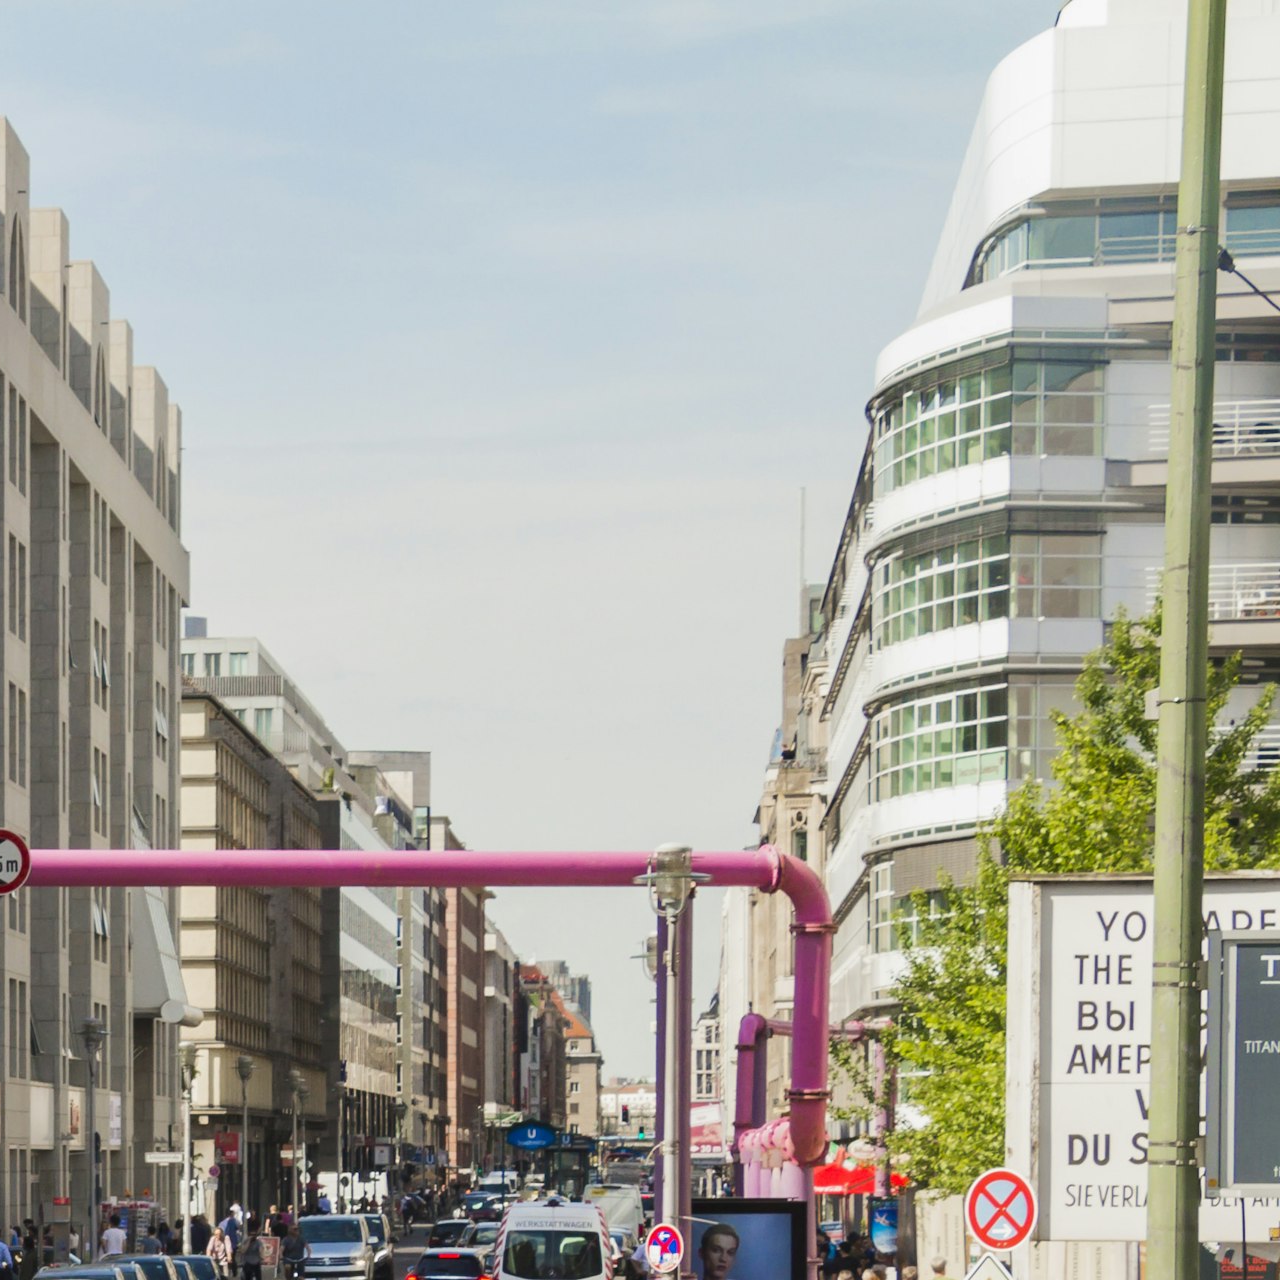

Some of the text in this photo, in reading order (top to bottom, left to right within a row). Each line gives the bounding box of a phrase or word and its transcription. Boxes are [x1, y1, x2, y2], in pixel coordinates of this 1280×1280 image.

[6, 860, 18, 873] m
[1075, 955, 1132, 985] THE
[1077, 1001, 1135, 1031] ВЫ
[528, 1129, 536, 1138] U
[1067, 1134, 1111, 1165] DU
[1065, 1184, 1093, 1208] SIE
[515, 1220, 593, 1229] WERKSTATTWAGEN
